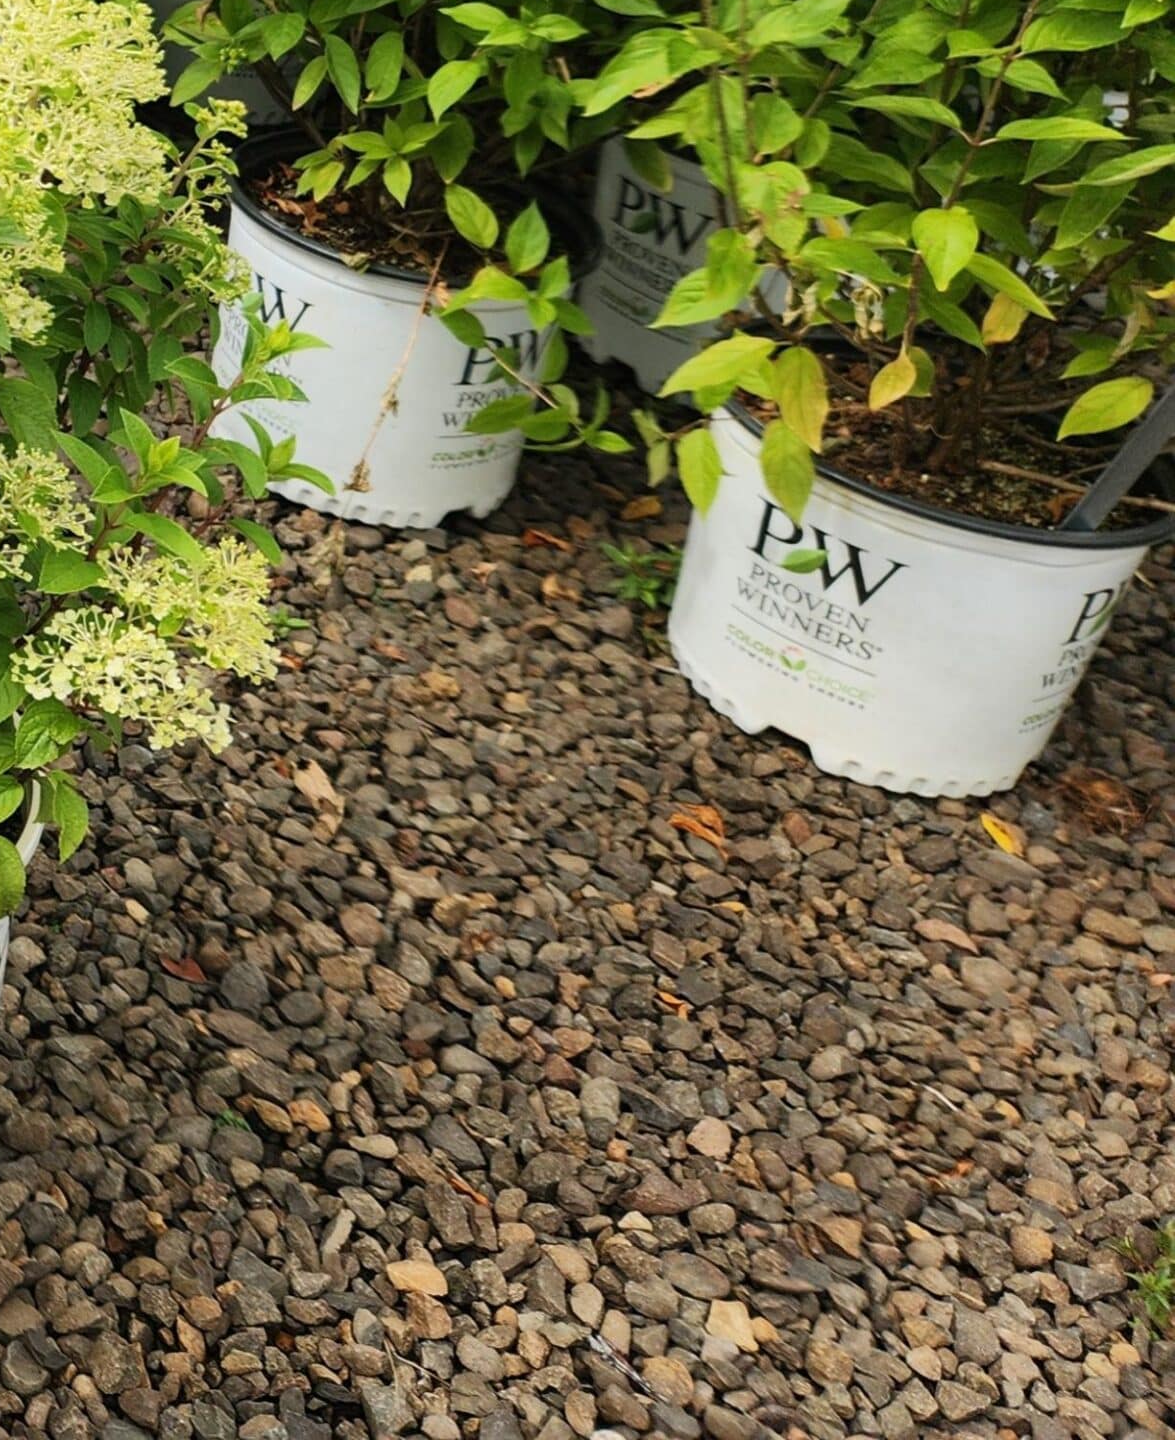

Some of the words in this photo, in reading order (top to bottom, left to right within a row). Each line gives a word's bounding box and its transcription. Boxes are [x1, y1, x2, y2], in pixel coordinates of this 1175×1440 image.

[610, 176, 714, 256] PW
[255, 272, 315, 333] W
[746, 494, 910, 606] PW
[749, 562, 871, 633] PROVEN
[727, 623, 775, 657] COLOR
